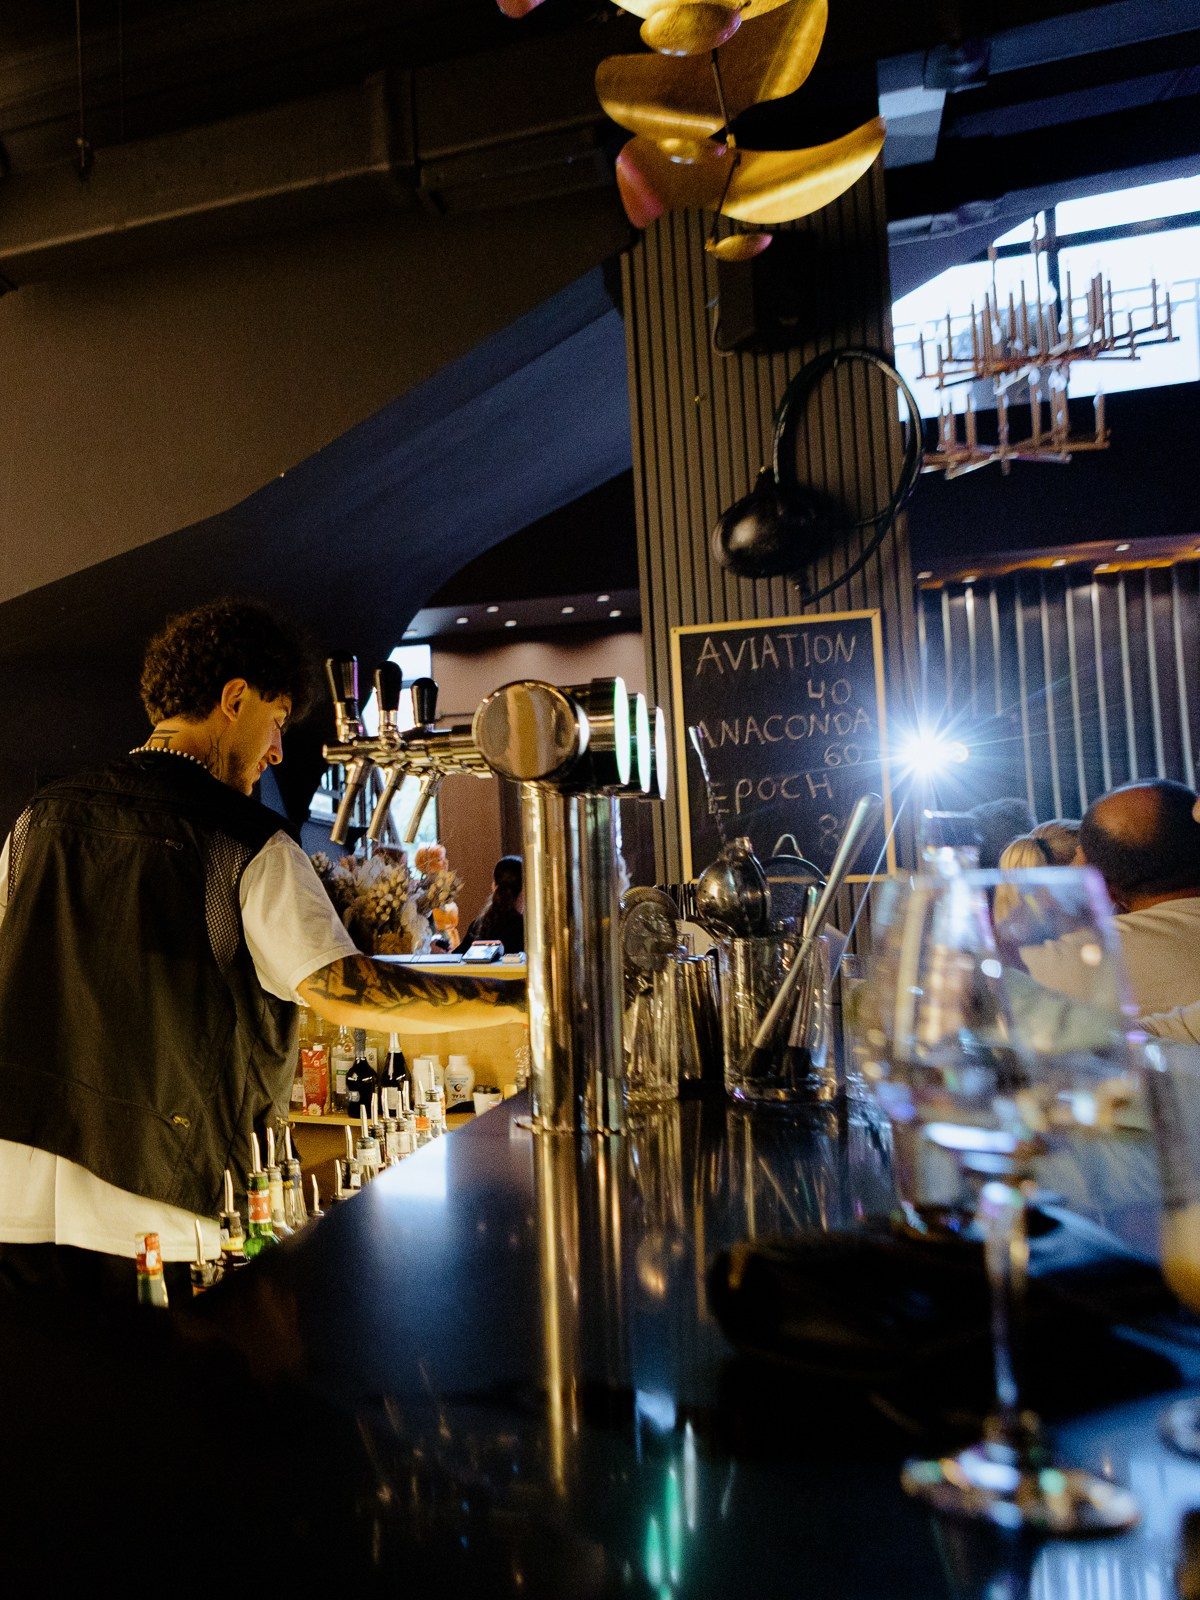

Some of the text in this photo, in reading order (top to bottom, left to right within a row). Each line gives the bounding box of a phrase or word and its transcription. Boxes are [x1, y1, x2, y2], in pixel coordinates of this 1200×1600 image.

[696, 633, 856, 675] AVIATION
[808, 679, 850, 708] 40
[697, 708, 872, 748] ANACONDA
[823, 742, 862, 767] 60
[708, 772, 833, 814] EPOCH
